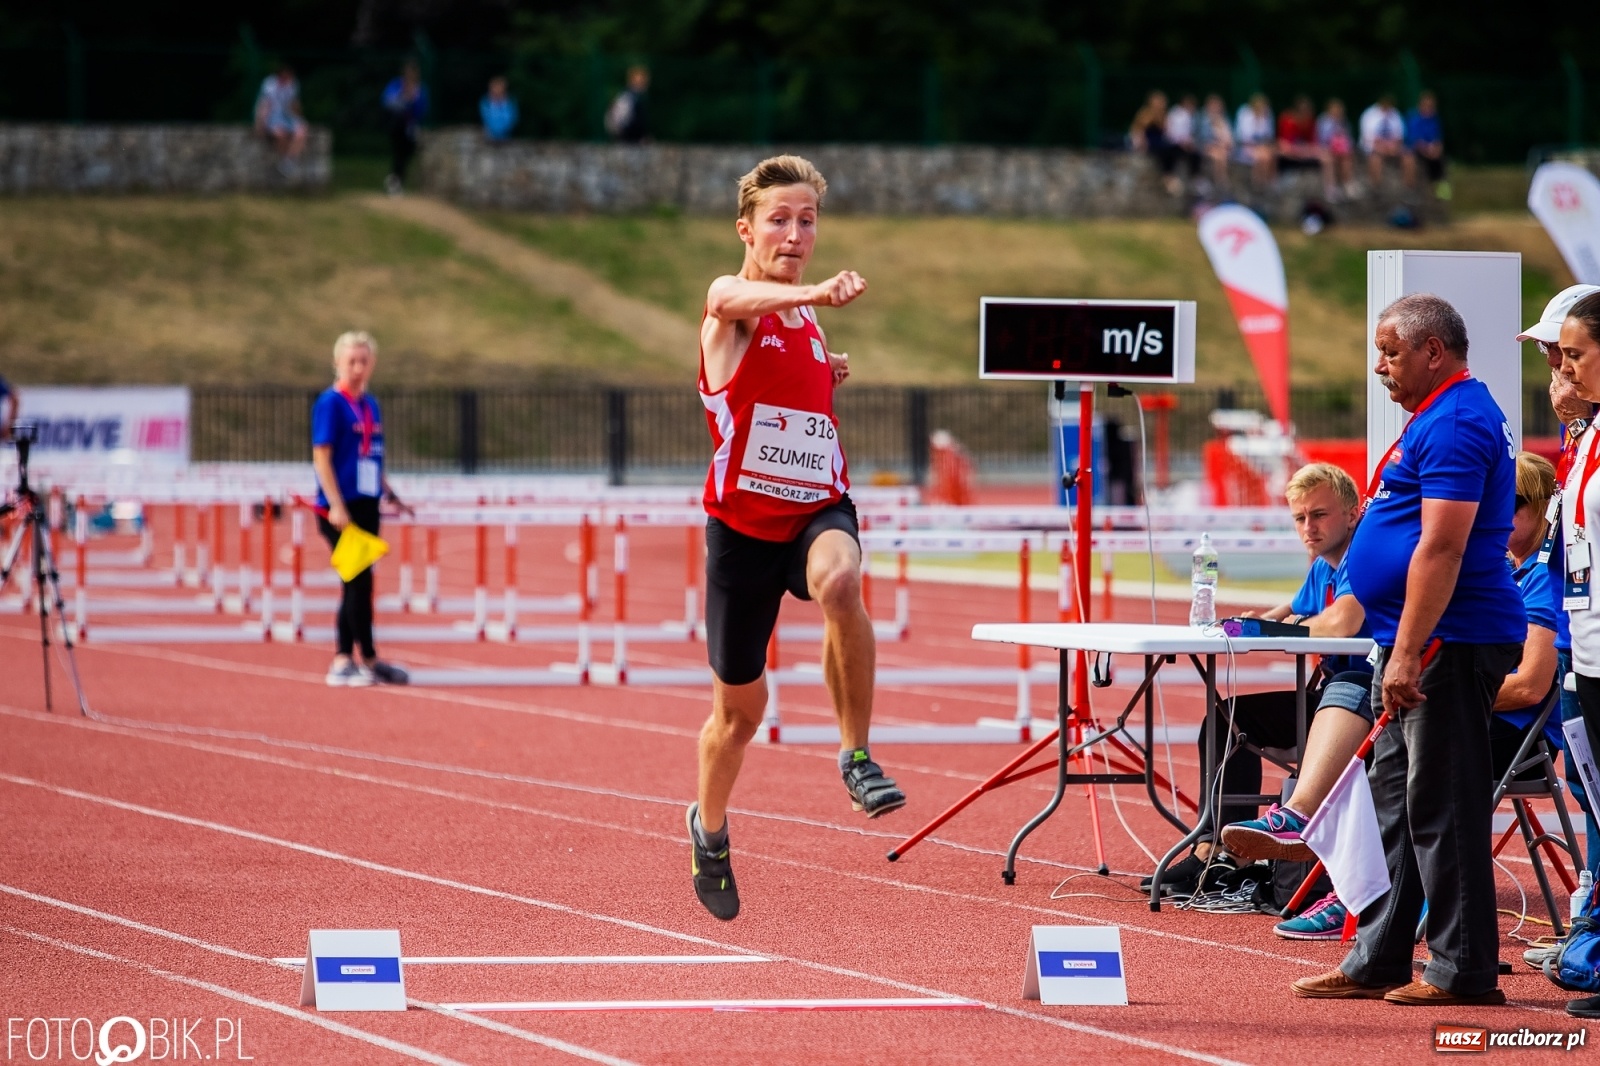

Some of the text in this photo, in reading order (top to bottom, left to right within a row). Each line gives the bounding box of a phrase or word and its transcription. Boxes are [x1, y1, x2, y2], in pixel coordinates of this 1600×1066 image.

[1102, 321, 1163, 362] m/s
[805, 417, 834, 440] 318
[758, 445, 825, 471] SZUMIEC
[749, 480, 801, 500] RACIBÓRZ
